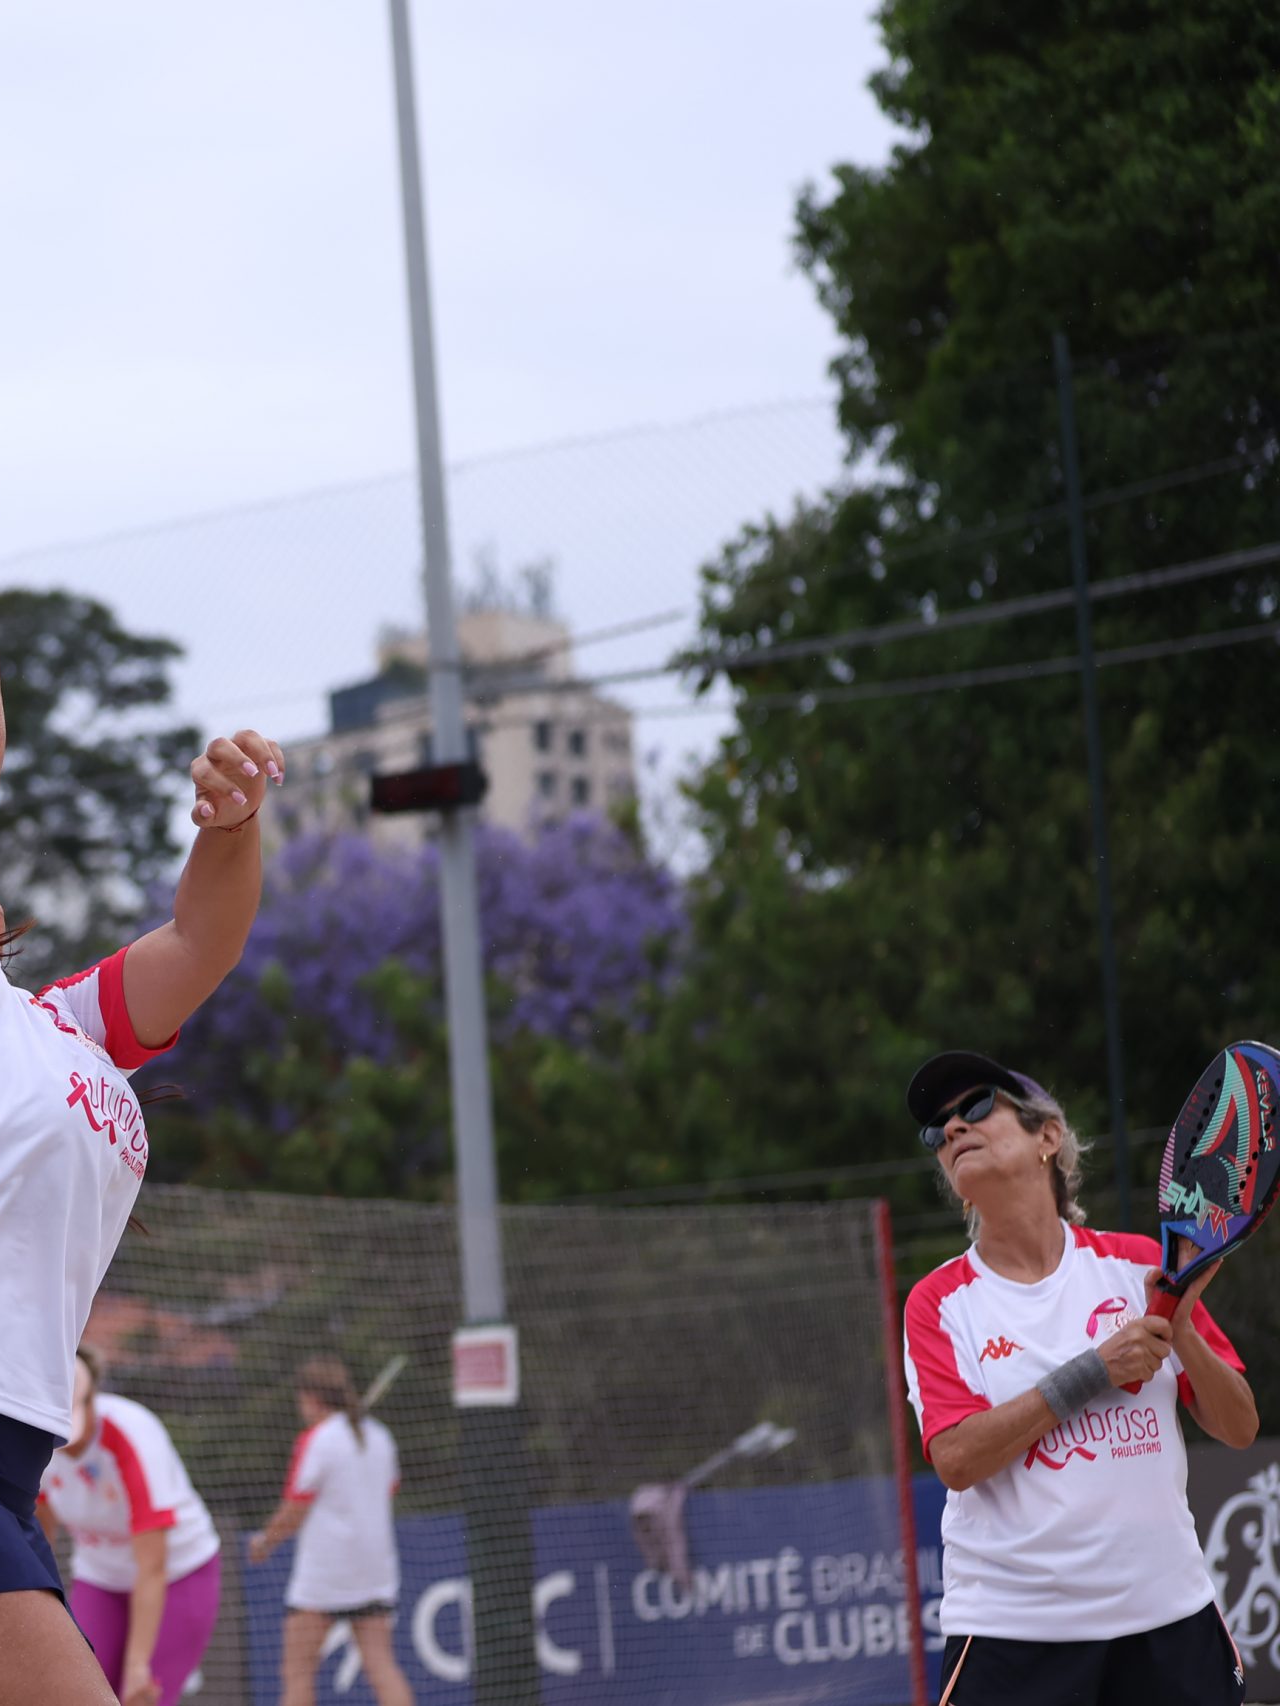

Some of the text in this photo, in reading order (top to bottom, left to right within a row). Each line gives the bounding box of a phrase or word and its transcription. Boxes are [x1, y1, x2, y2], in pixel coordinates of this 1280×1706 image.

[1256, 1067, 1276, 1152] KEVLAR
[1161, 1180, 1234, 1244] SHARK
[632, 1546, 808, 1622] COMITÊ
